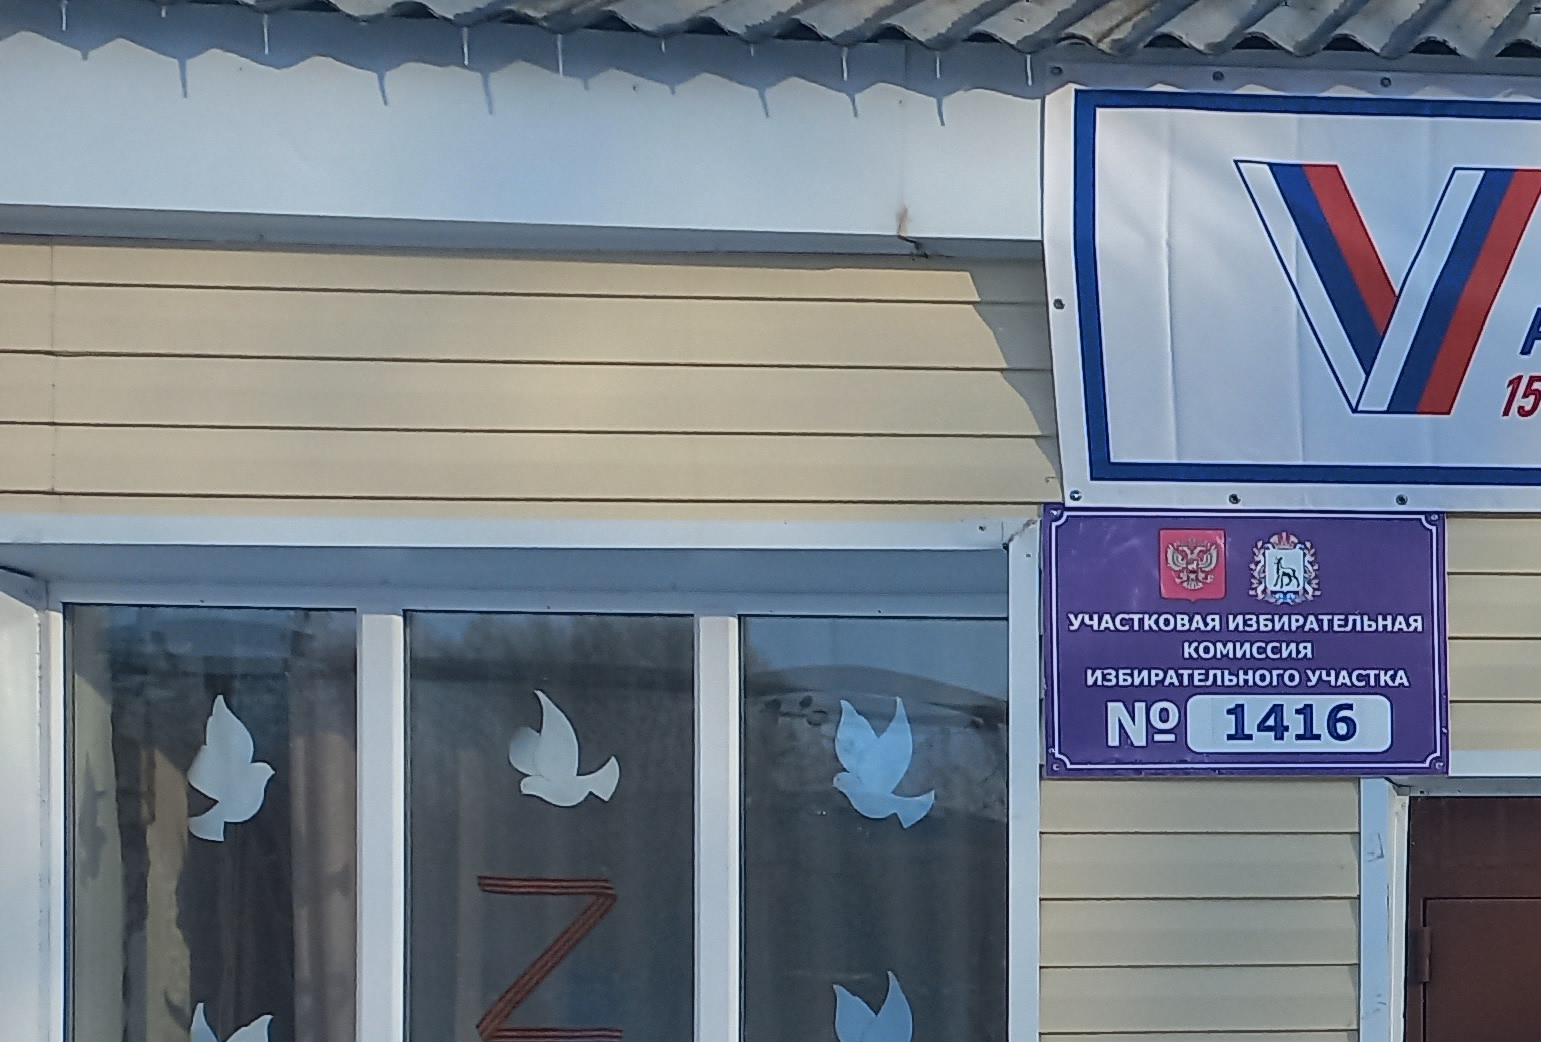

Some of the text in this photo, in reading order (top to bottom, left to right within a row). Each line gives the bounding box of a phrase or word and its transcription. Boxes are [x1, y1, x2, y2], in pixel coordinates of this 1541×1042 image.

[1068, 613, 1423, 632] УЧАСТКОВАЯ ИЗБИРАТЕЛЬНАЯ
[1183, 642, 1313, 659] КОМИССИЯ
[1086, 669, 1409, 687] ИЗБИРАТЕЛЬНОГО УЧАСТКА
[1106, 701, 1358, 747] № 1416
